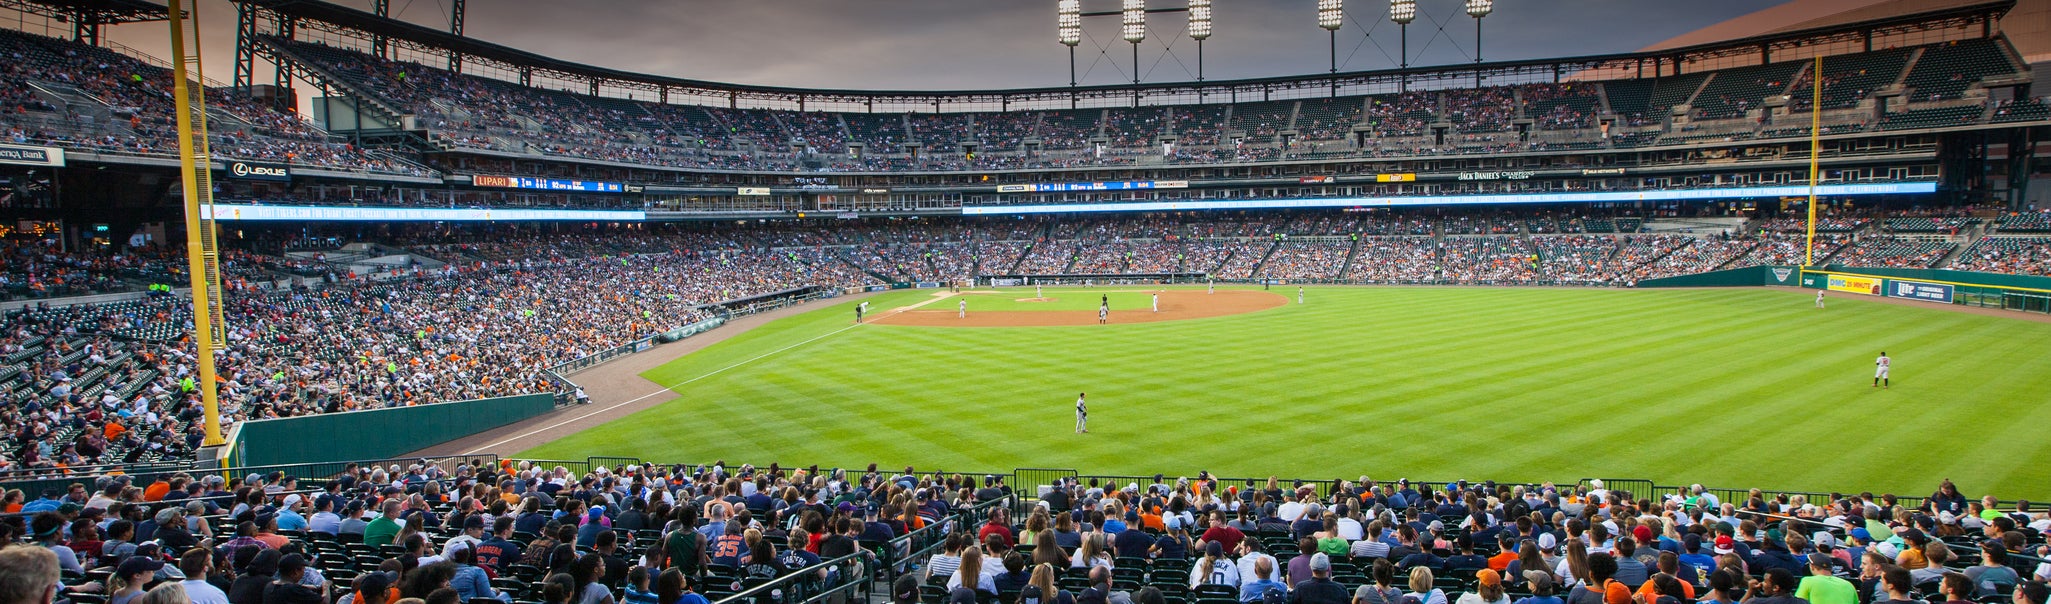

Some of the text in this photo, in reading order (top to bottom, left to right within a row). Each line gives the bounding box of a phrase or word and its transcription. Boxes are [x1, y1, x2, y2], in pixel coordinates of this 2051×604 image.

[22, 150, 44, 159] Bank
[248, 166, 287, 177] LEXUS
[1458, 171, 1500, 180] JACK DANIEL'S
[479, 176, 506, 187] LIPARI
[1829, 278, 1846, 287] DMC
[1853, 281, 1871, 289] MINUTE
[1897, 282, 1915, 296] Lite
[476, 545, 503, 556] CABRERA
[715, 541, 740, 557] 35
